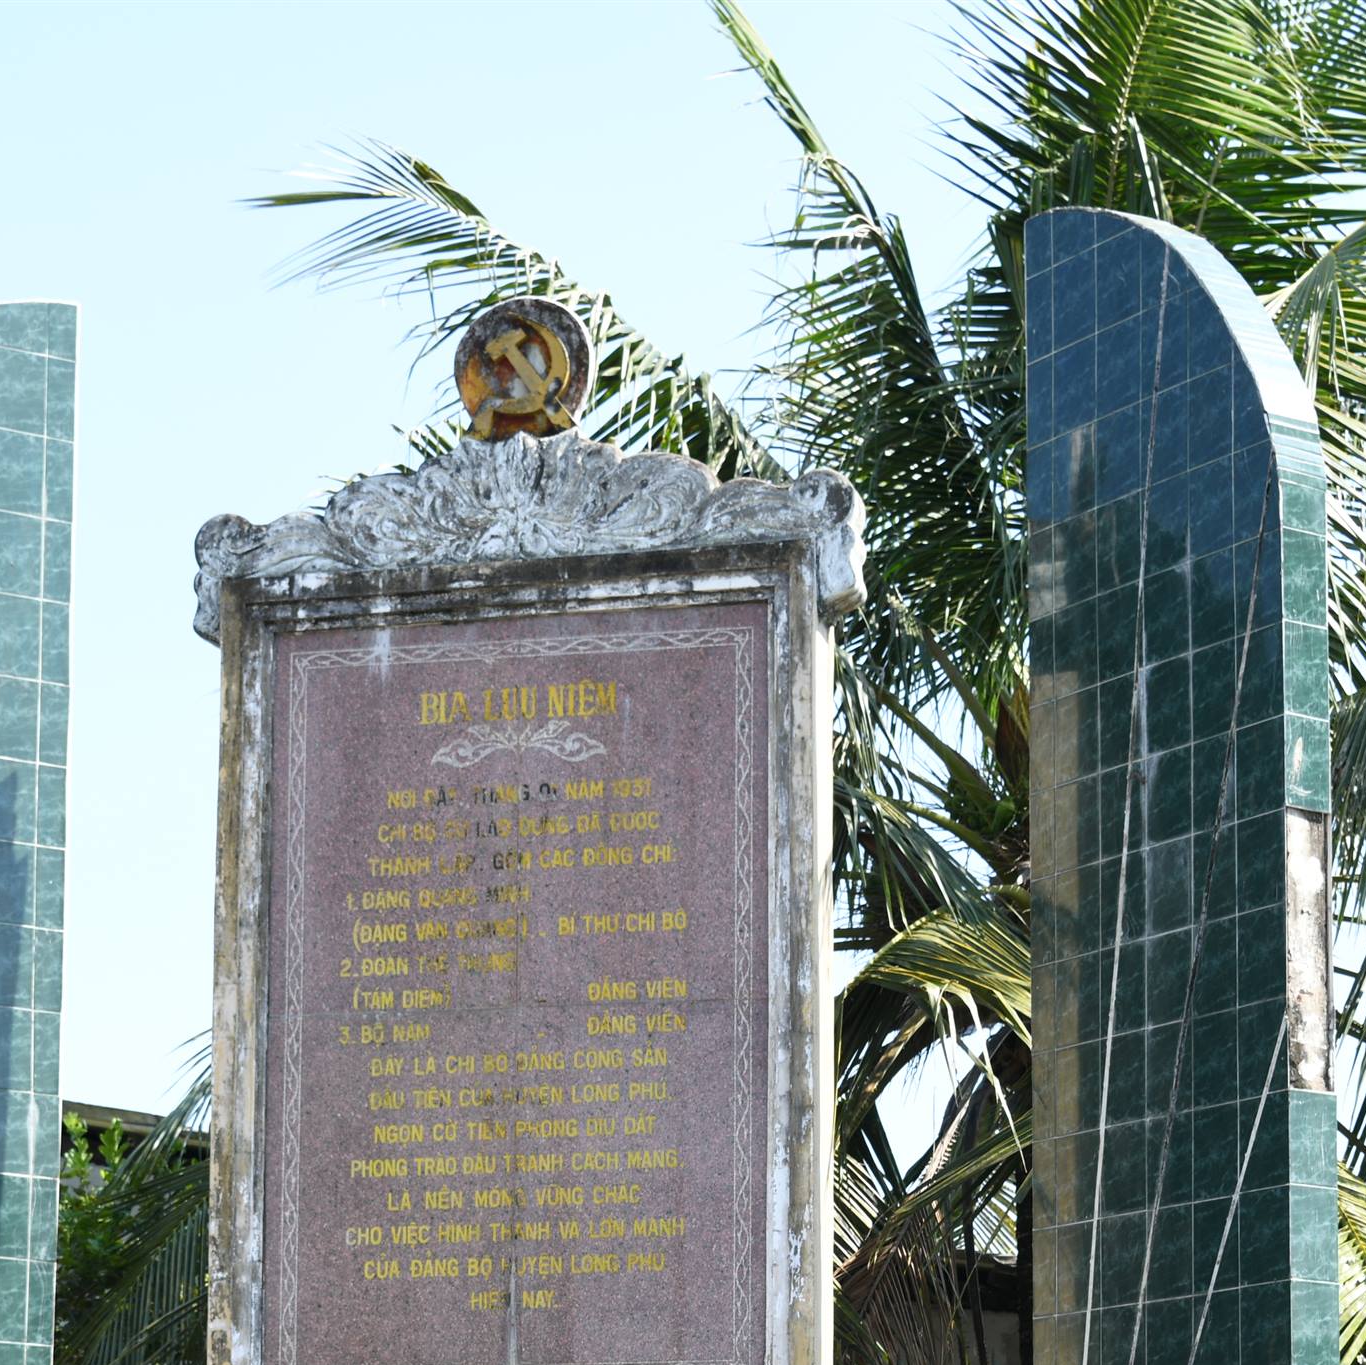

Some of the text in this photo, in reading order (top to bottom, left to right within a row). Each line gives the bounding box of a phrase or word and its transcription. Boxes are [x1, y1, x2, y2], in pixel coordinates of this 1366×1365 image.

[420, 690, 473, 725] BIA
[626, 911, 656, 933] CHI
[646, 975, 688, 999] VIÊN
[646, 1008, 688, 1034] VIÊN
[414, 1050, 437, 1075] LÀ
[446, 1054, 476, 1074] CHI
[571, 1083, 621, 1105] LONG
[515, 1118, 579, 1138] PHONG
[351, 1157, 408, 1178] PHONG
[345, 1225, 383, 1247] CHO
[570, 1252, 621, 1275] LONG
